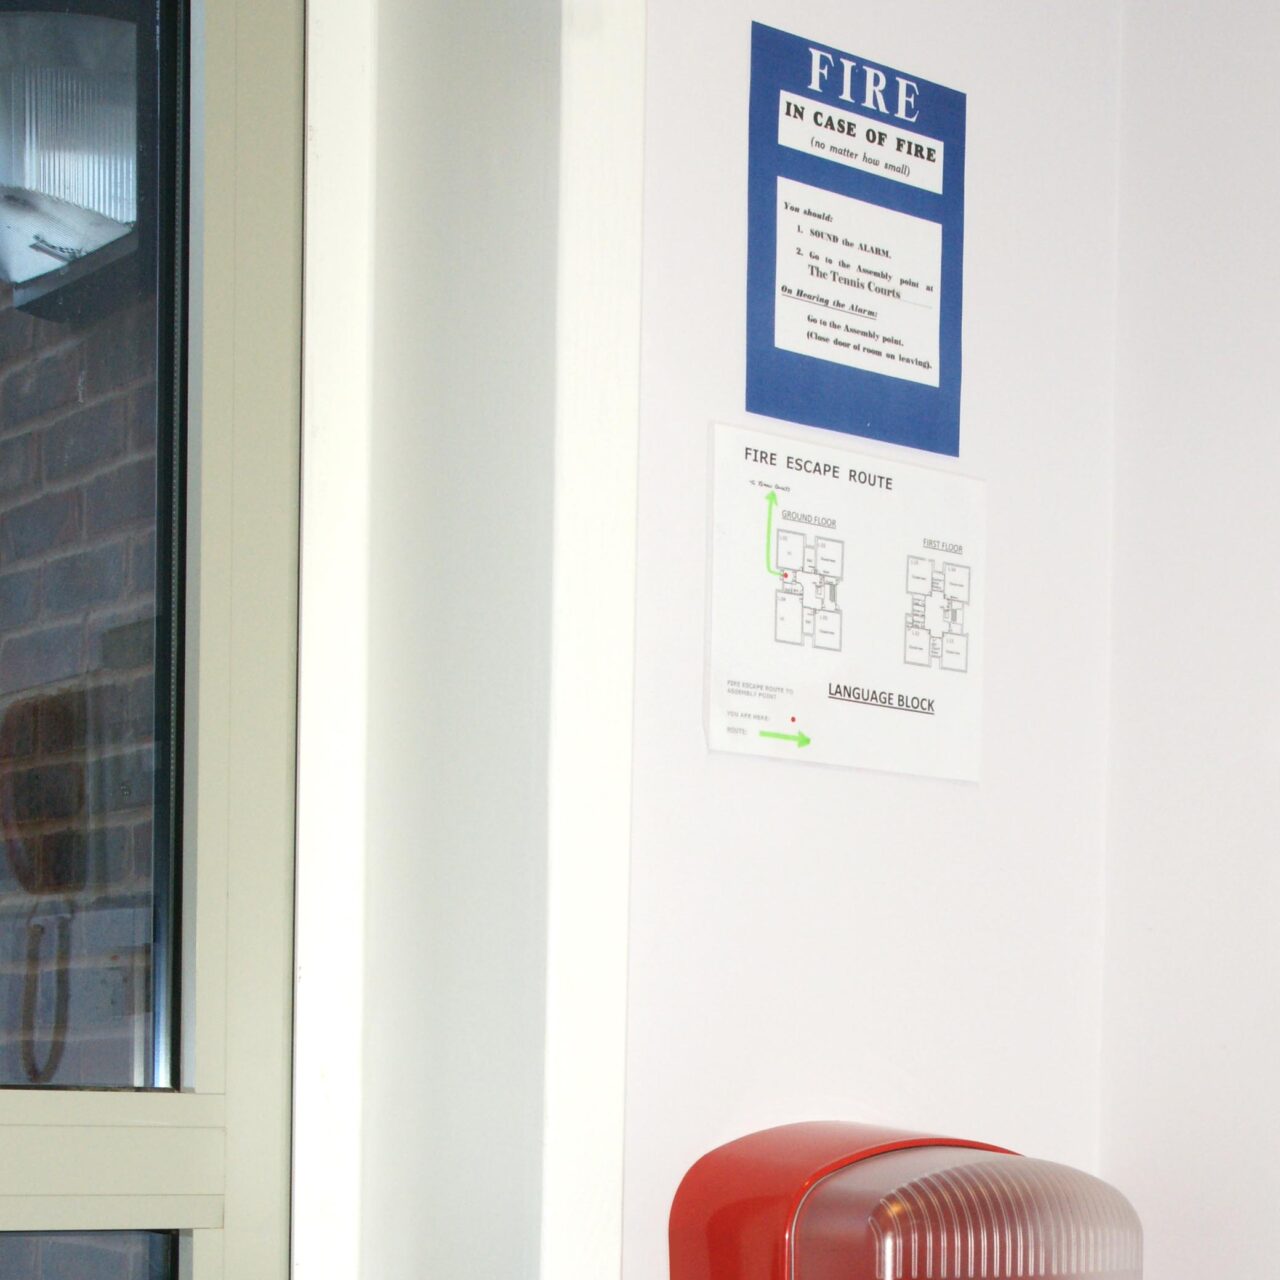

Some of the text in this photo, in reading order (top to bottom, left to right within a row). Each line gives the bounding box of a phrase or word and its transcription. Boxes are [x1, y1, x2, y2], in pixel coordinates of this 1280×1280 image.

[807, 47, 920, 123] FIRE
[785, 101, 937, 163] IN CASE OF FIRE
[810, 136, 911, 177] (no matter how small)
[783, 201, 834, 222] You should:
[809, 228, 839, 243] SOUND
[842, 238, 855, 248] the
[857, 243, 892, 259] ALARM.
[808, 264, 901, 299] The Tennis Courts
[809, 251, 820, 261] Go
[825, 255, 833, 264] to
[838, 260, 851, 270] the
[856, 265, 893, 282] Assembly
[899, 277, 920, 290] point
[925, 284, 934, 292] at
[781, 284, 878, 317] On Hearing the Alarm:
[806, 330, 830, 344] (Close
[833, 337, 851, 349] door
[862, 346, 882, 358] room
[886, 352, 896, 361] on
[807, 314, 904, 347] Go to the Assembly point.
[744, 446, 893, 490] FIRE ESCAPE ROUTE
[782, 510, 837, 527] GROUND FLOOR
[923, 538, 963, 553] FIRST FLOOR
[828, 682, 935, 712] LANGUAGE BLOCK
